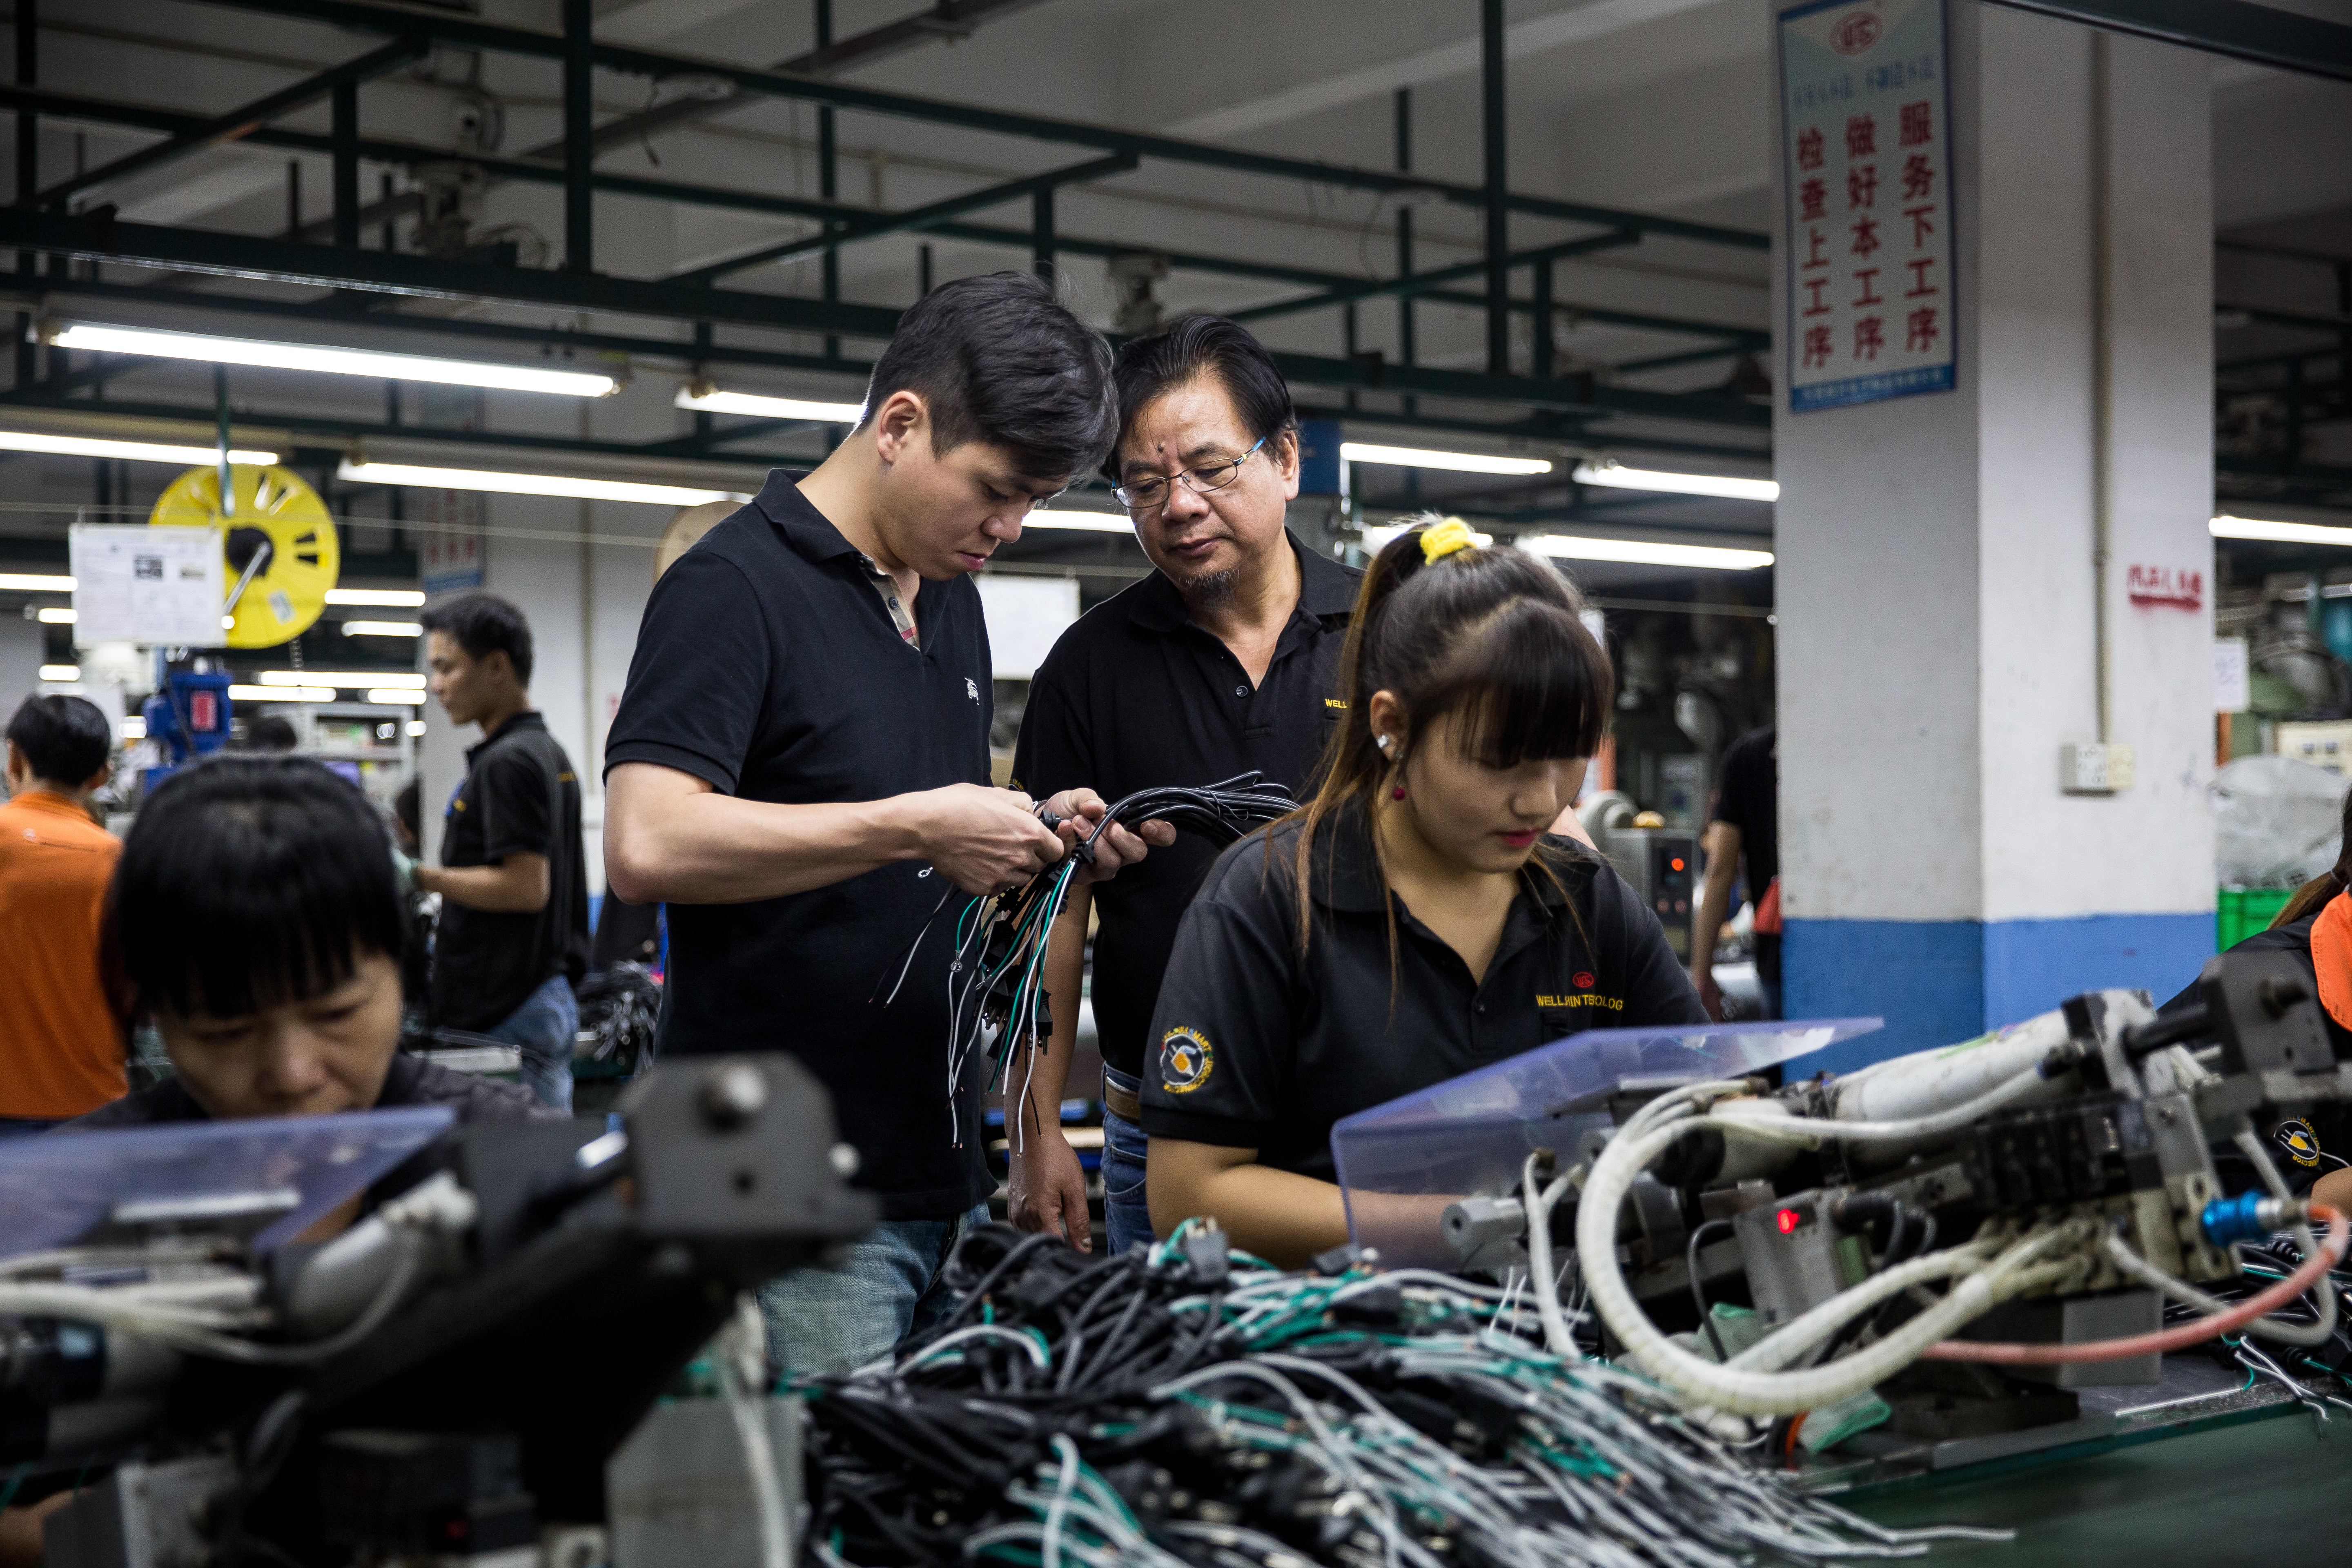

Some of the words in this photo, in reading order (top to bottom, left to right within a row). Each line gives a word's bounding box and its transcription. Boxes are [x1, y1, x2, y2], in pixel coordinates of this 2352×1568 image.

[1797, 126, 1832, 369] 检查上工序
[1845, 114, 1883, 361] 做好本工序
[1899, 100, 1938, 352] 服务下工序
